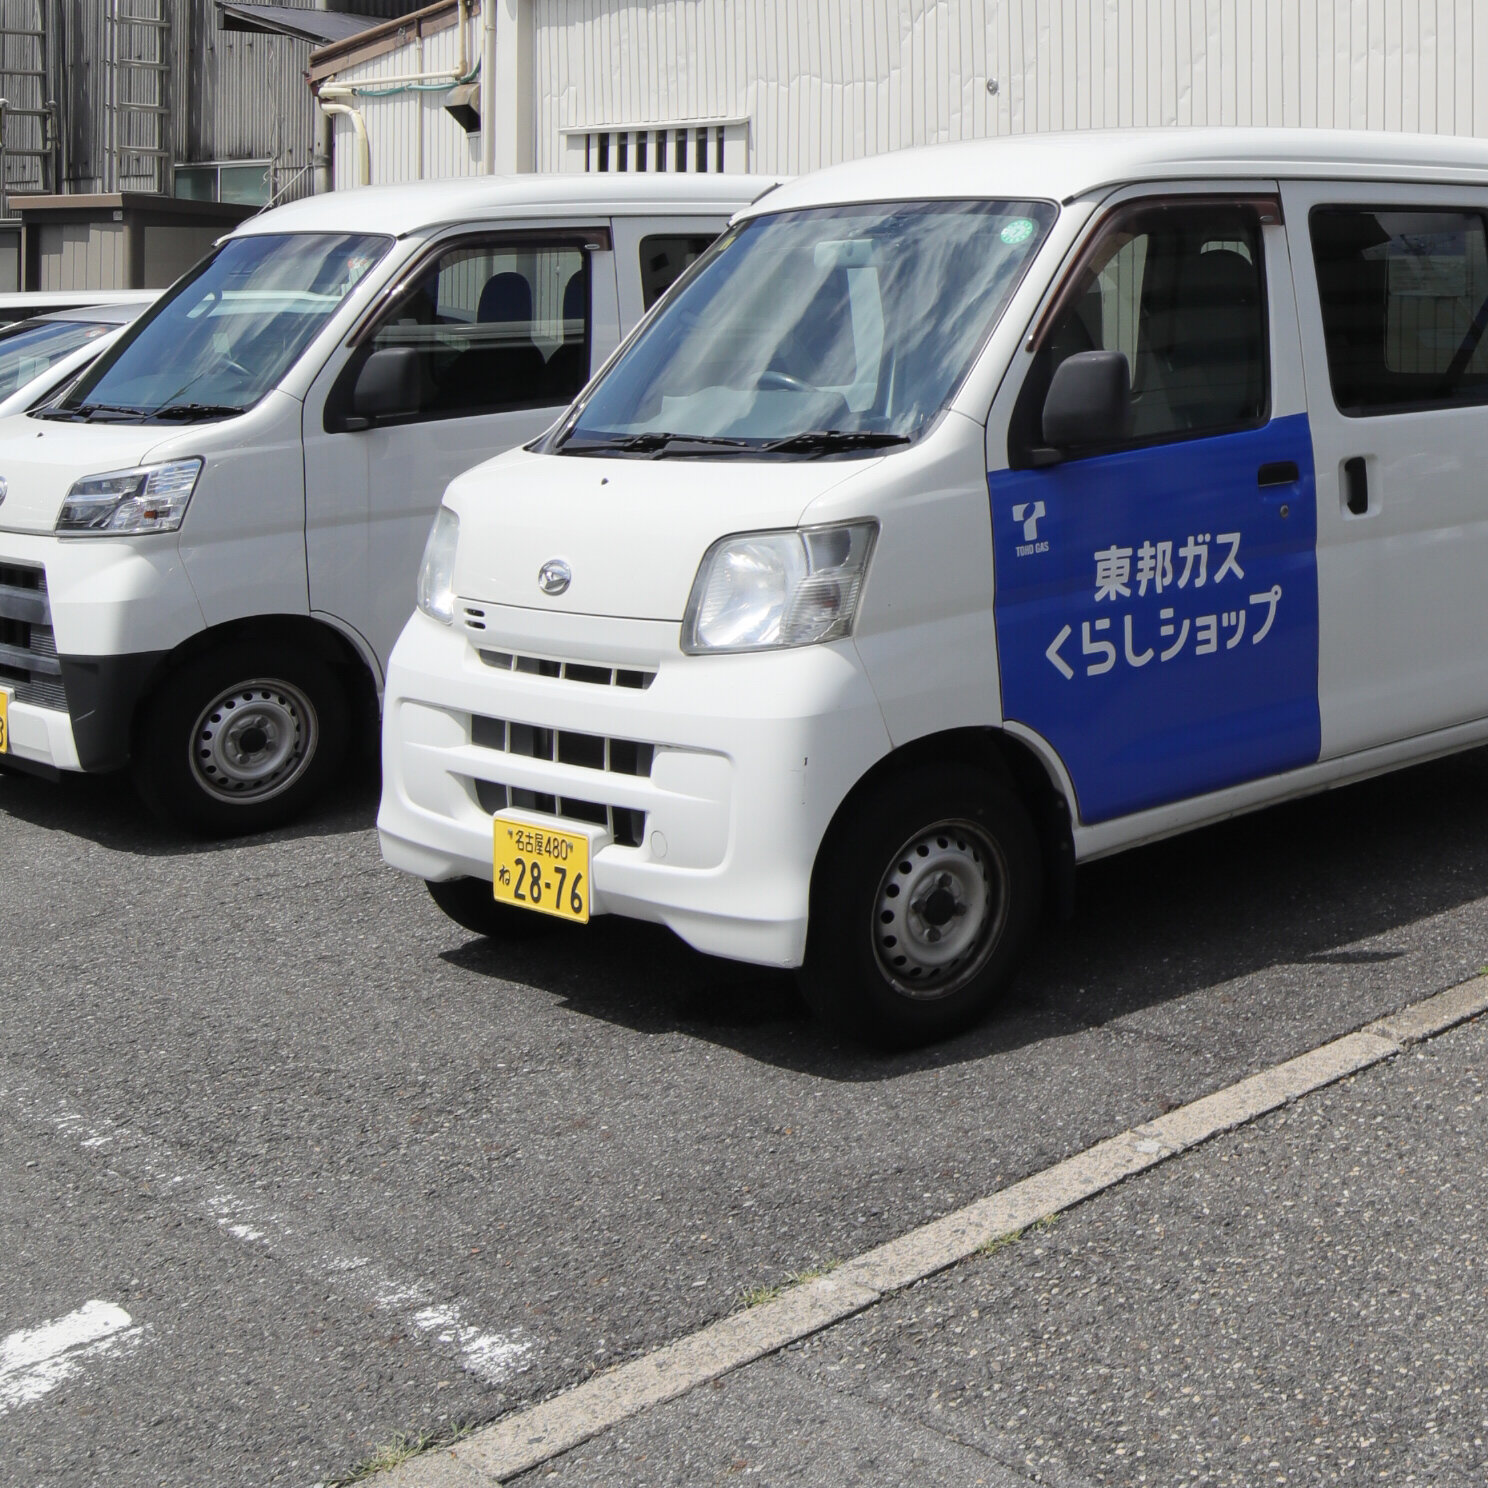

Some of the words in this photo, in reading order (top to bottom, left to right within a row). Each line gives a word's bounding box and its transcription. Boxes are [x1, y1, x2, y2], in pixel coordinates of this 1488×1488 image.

[1015, 543, 1034, 557] TOHO
[1035, 541, 1049, 554] GAS
[1093, 532, 1245, 602] 東邦ガス
[1045, 584, 1283, 680] くらしショップ
[499, 864, 511, 886] ね
[514, 858, 583, 914] 28-76
